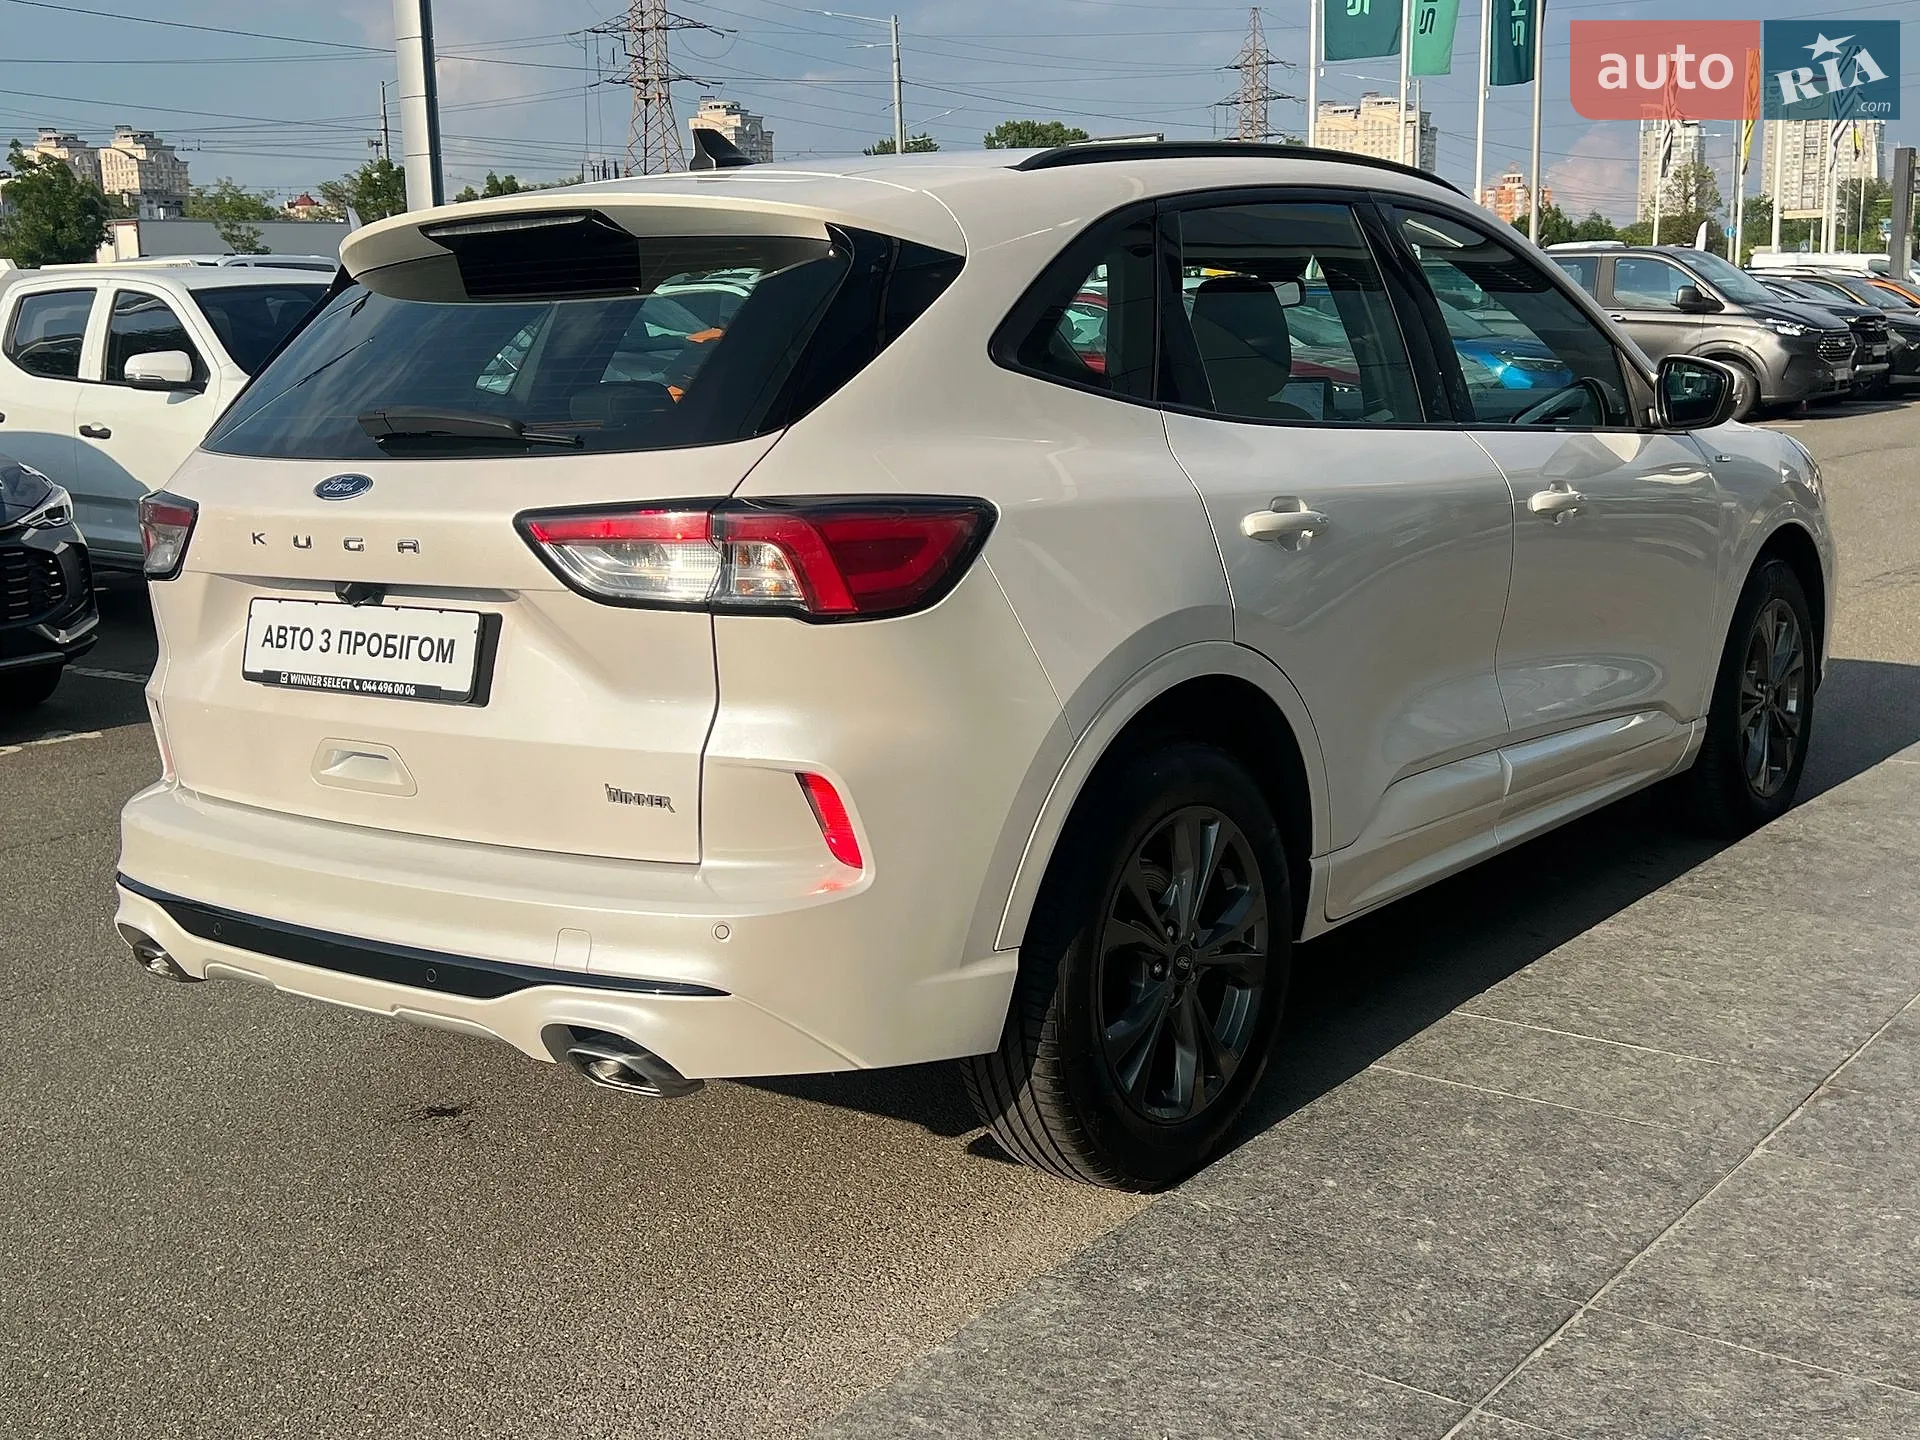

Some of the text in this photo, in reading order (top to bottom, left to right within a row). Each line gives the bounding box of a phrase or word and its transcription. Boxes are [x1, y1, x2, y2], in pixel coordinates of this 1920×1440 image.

[251, 531, 420, 554] KUGA
[261, 624, 456, 664] АВТО З ПРОБІГОМ
[290, 673, 416, 696] WINNER SELECT 044 496 00 06
[604, 783, 676, 813] WINNER
